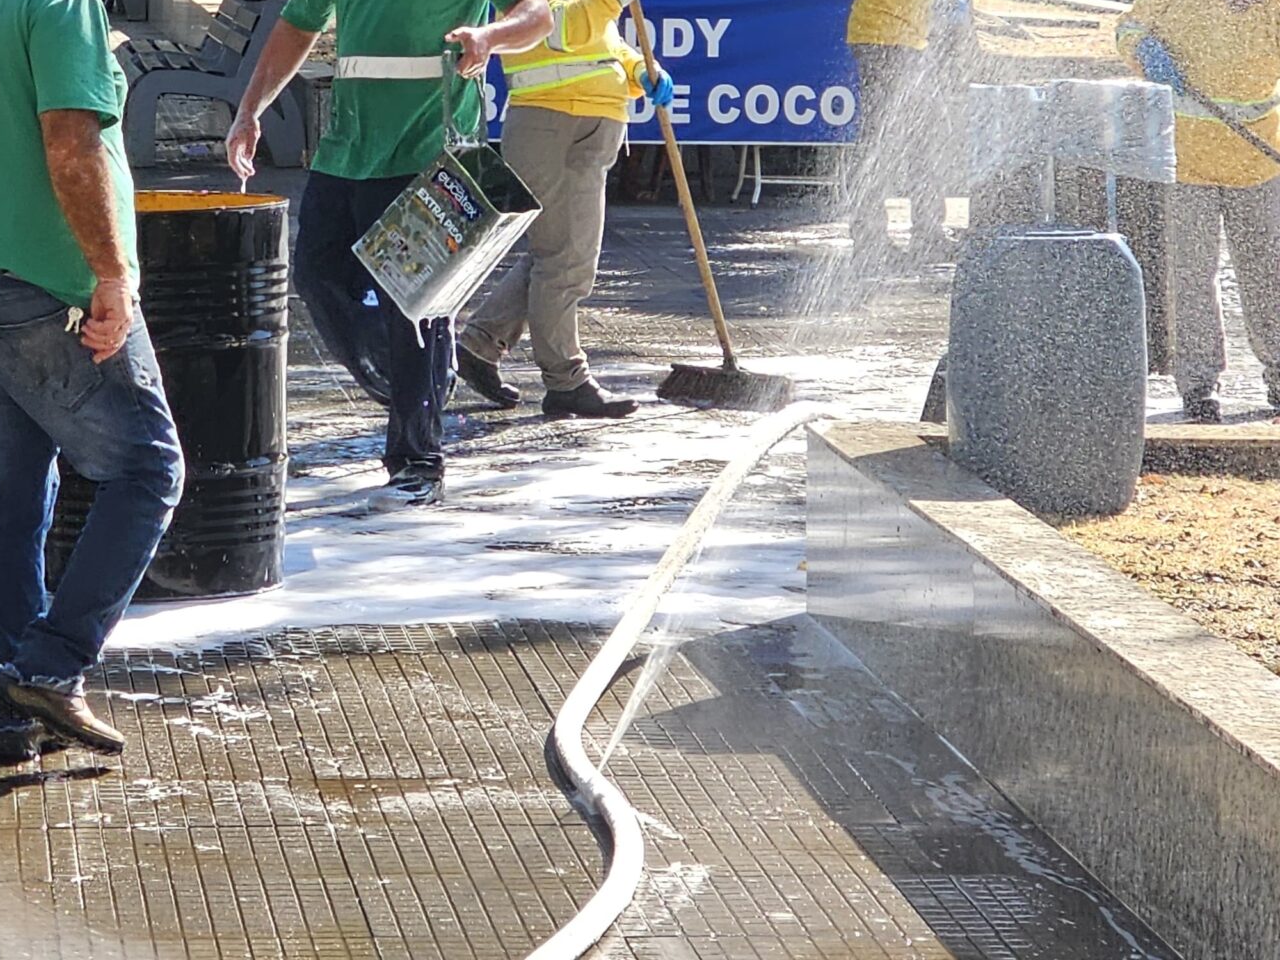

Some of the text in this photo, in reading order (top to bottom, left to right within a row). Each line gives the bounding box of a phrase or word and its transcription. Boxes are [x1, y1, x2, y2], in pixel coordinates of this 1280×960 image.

[624, 17, 733, 58] DDY
[707, 83, 856, 126] COCO
[416, 187, 446, 224] EXTRA
[443, 219, 463, 244] PISO
[438, 171, 477, 219] eucatex
